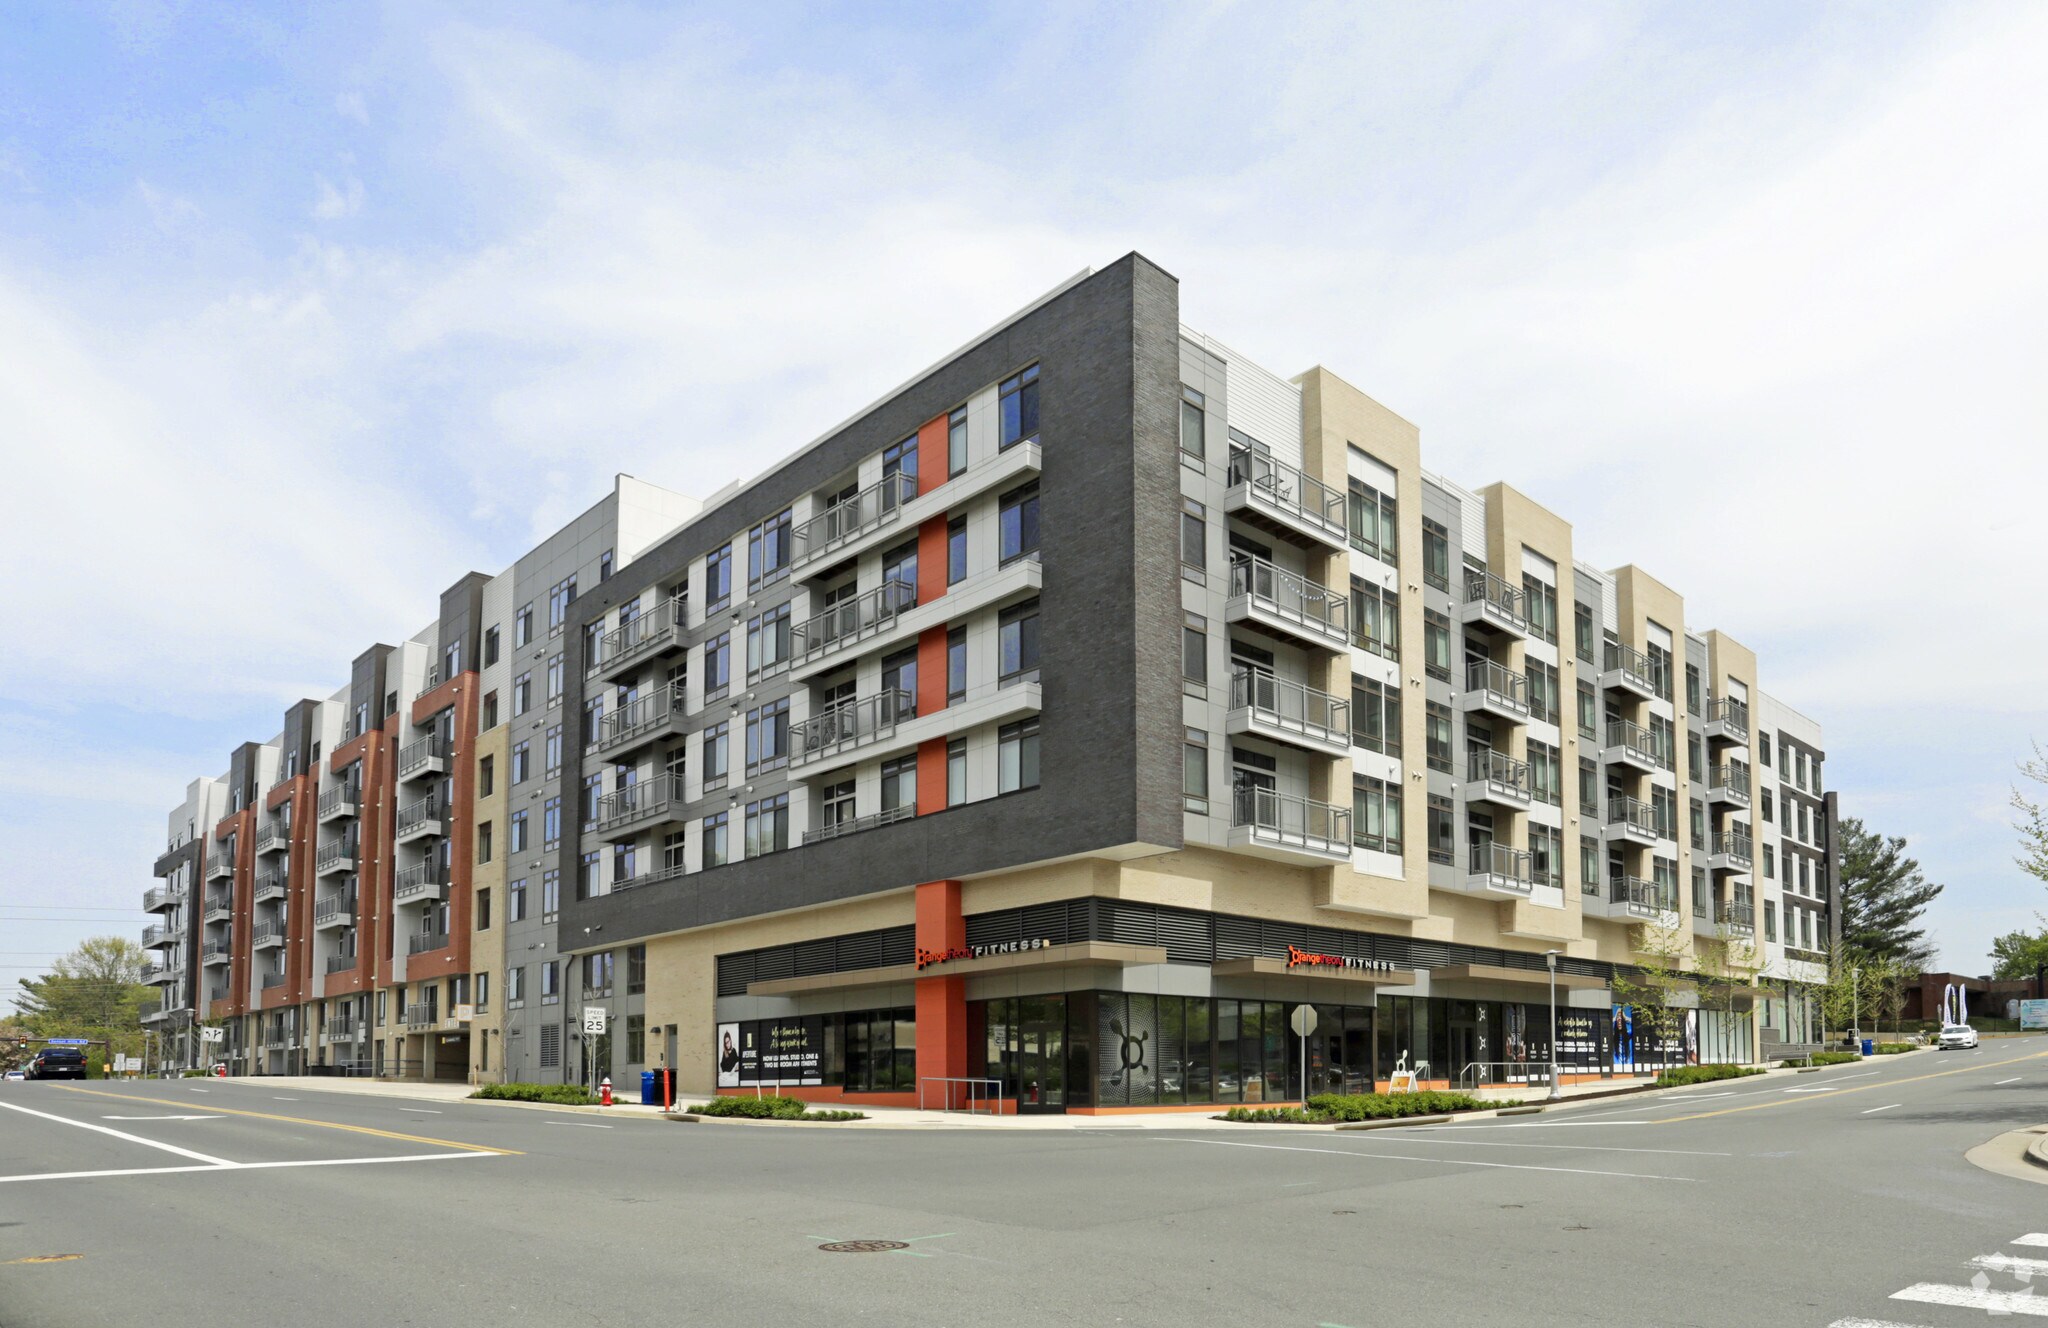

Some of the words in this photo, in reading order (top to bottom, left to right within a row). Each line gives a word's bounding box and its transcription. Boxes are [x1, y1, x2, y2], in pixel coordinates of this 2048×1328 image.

[975, 939, 1041, 956] FITNESS
[1346, 958, 1395, 971] FITNESS
[586, 1020, 603, 1031] 25
